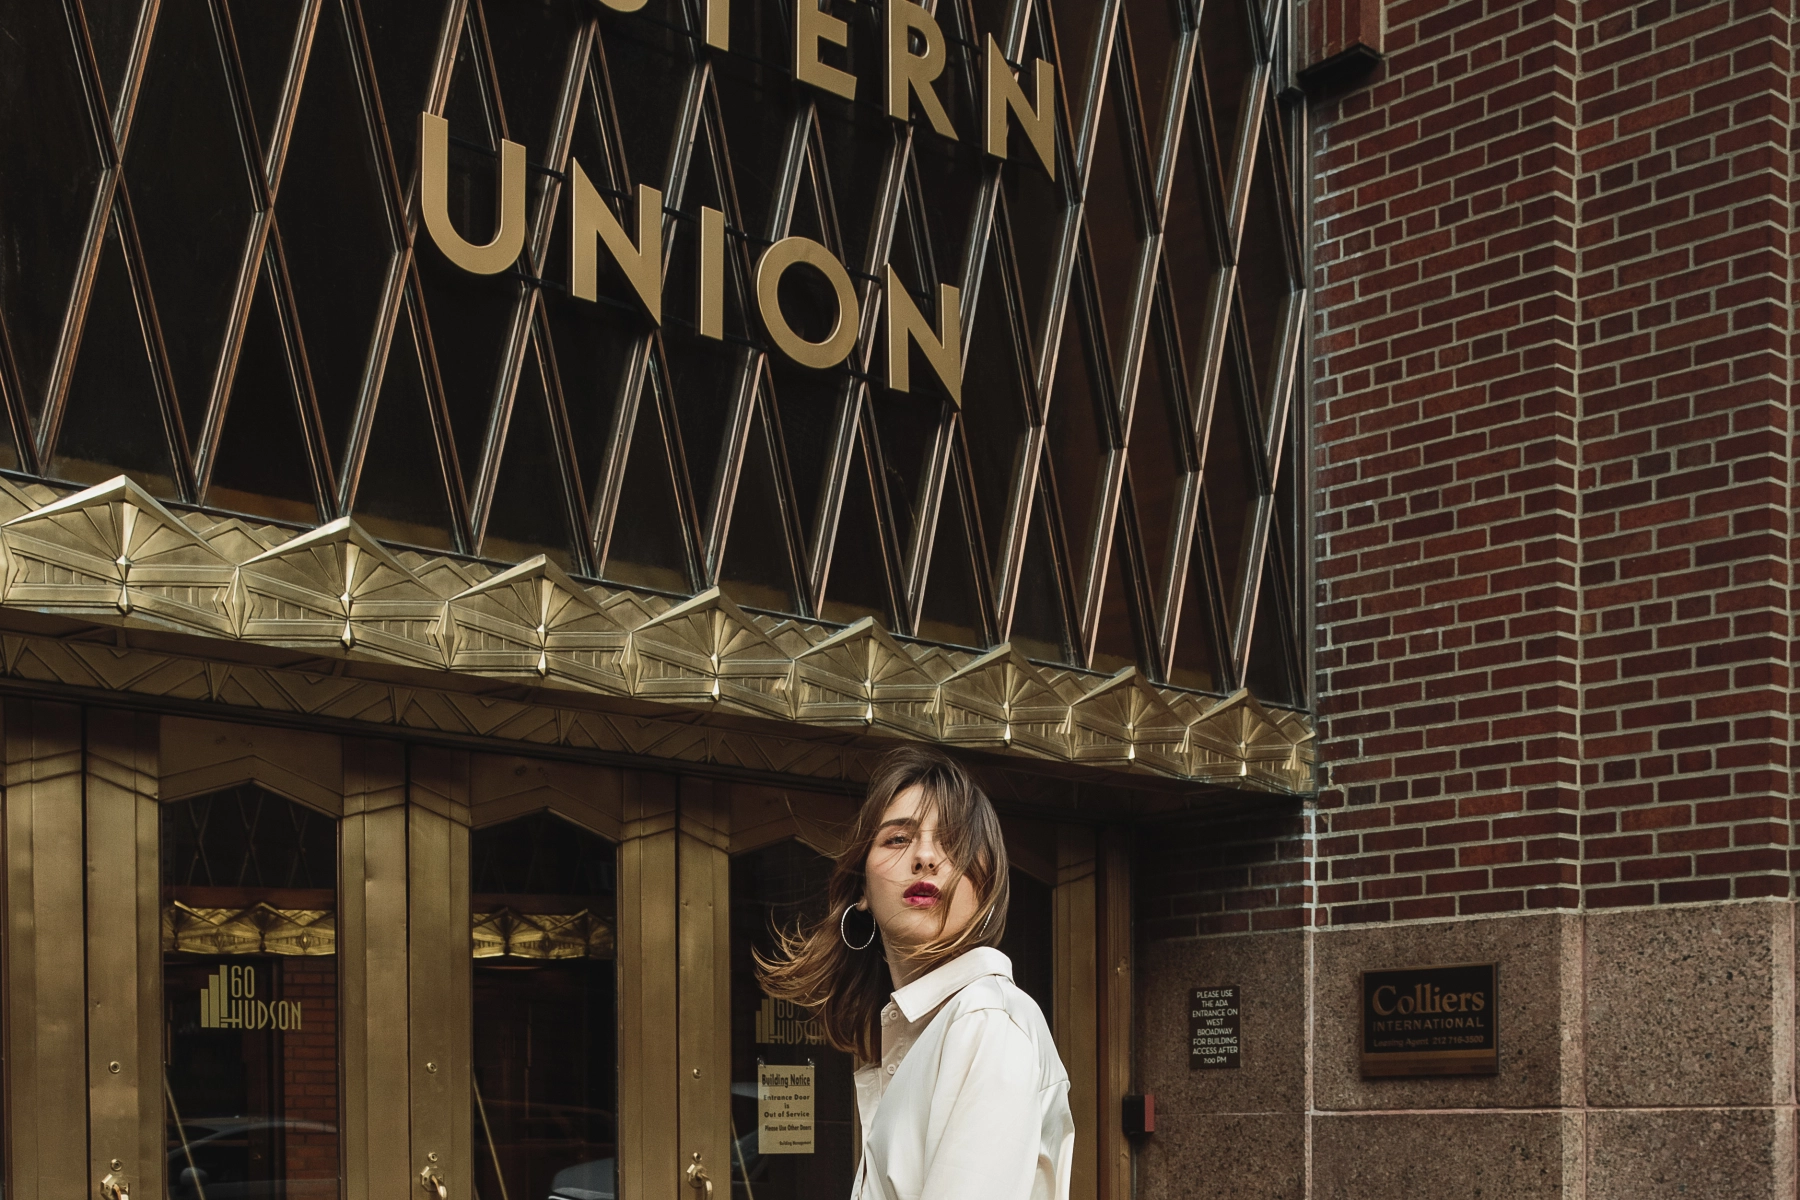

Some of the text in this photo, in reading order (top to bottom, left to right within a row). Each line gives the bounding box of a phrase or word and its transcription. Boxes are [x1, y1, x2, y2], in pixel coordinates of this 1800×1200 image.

[597, 0, 1055, 183] ERN
[421, 111, 962, 412] UNION
[231, 965, 255, 998] 60
[1197, 989, 1233, 998] PLEASE USE
[1372, 983, 1485, 1016] Colliers
[1202, 999, 1228, 1008] THE ADA
[221, 1000, 302, 1030] HUDSON
[1192, 1008, 1238, 1017] ENTRANCE ON
[1206, 1018, 1224, 1026] WEST
[1373, 1017, 1485, 1032] INTERNATIONAL
[1197, 1028, 1233, 1036] BROADWAY
[1373, 1038, 1404, 1048] Leasing
[1405, 1037, 1429, 1048] Agent
[1432, 1036, 1446, 1045] 212
[761, 1073, 811, 1088] Building Notice
[777, 1110, 785, 1118] of
[786, 1110, 810, 1118] Service
